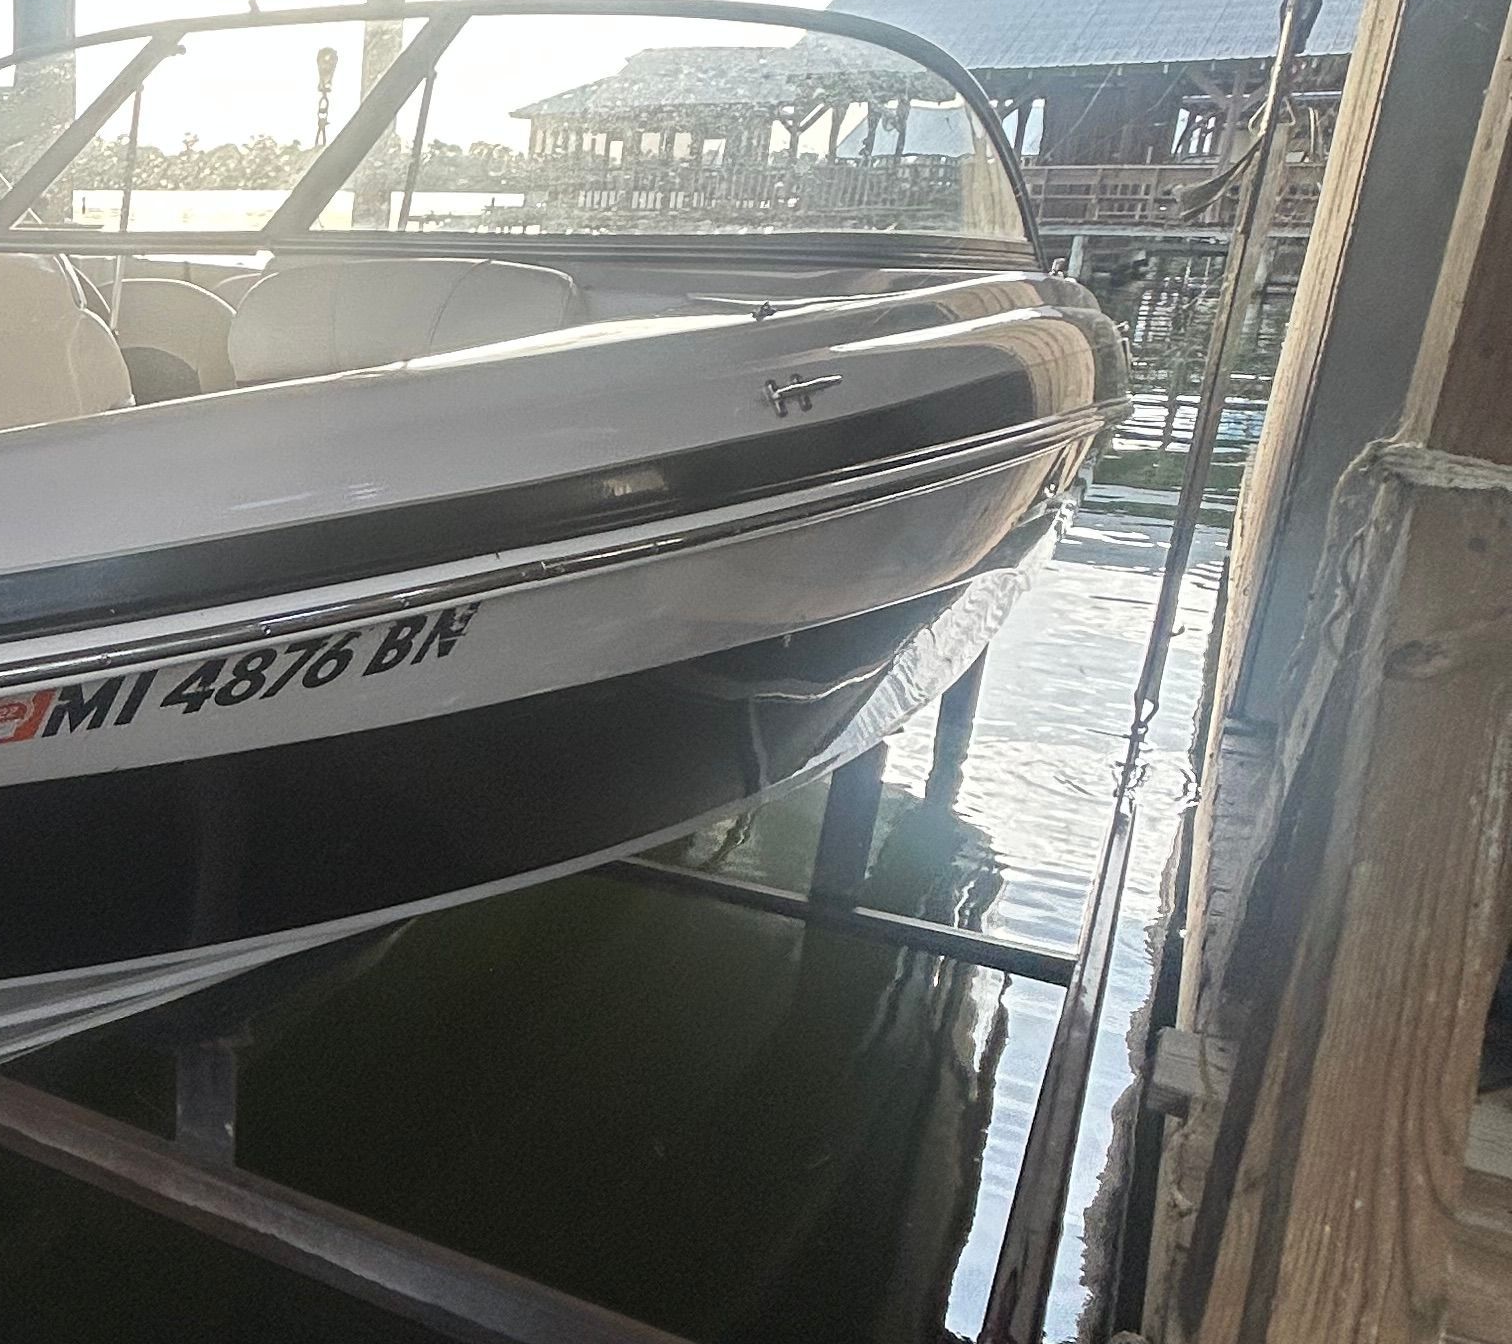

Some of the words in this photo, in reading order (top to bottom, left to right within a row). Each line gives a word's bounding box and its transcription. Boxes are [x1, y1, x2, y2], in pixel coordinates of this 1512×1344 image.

[41, 668, 159, 738] MI
[160, 630, 363, 714] 4876
[362, 601, 481, 677] BN
